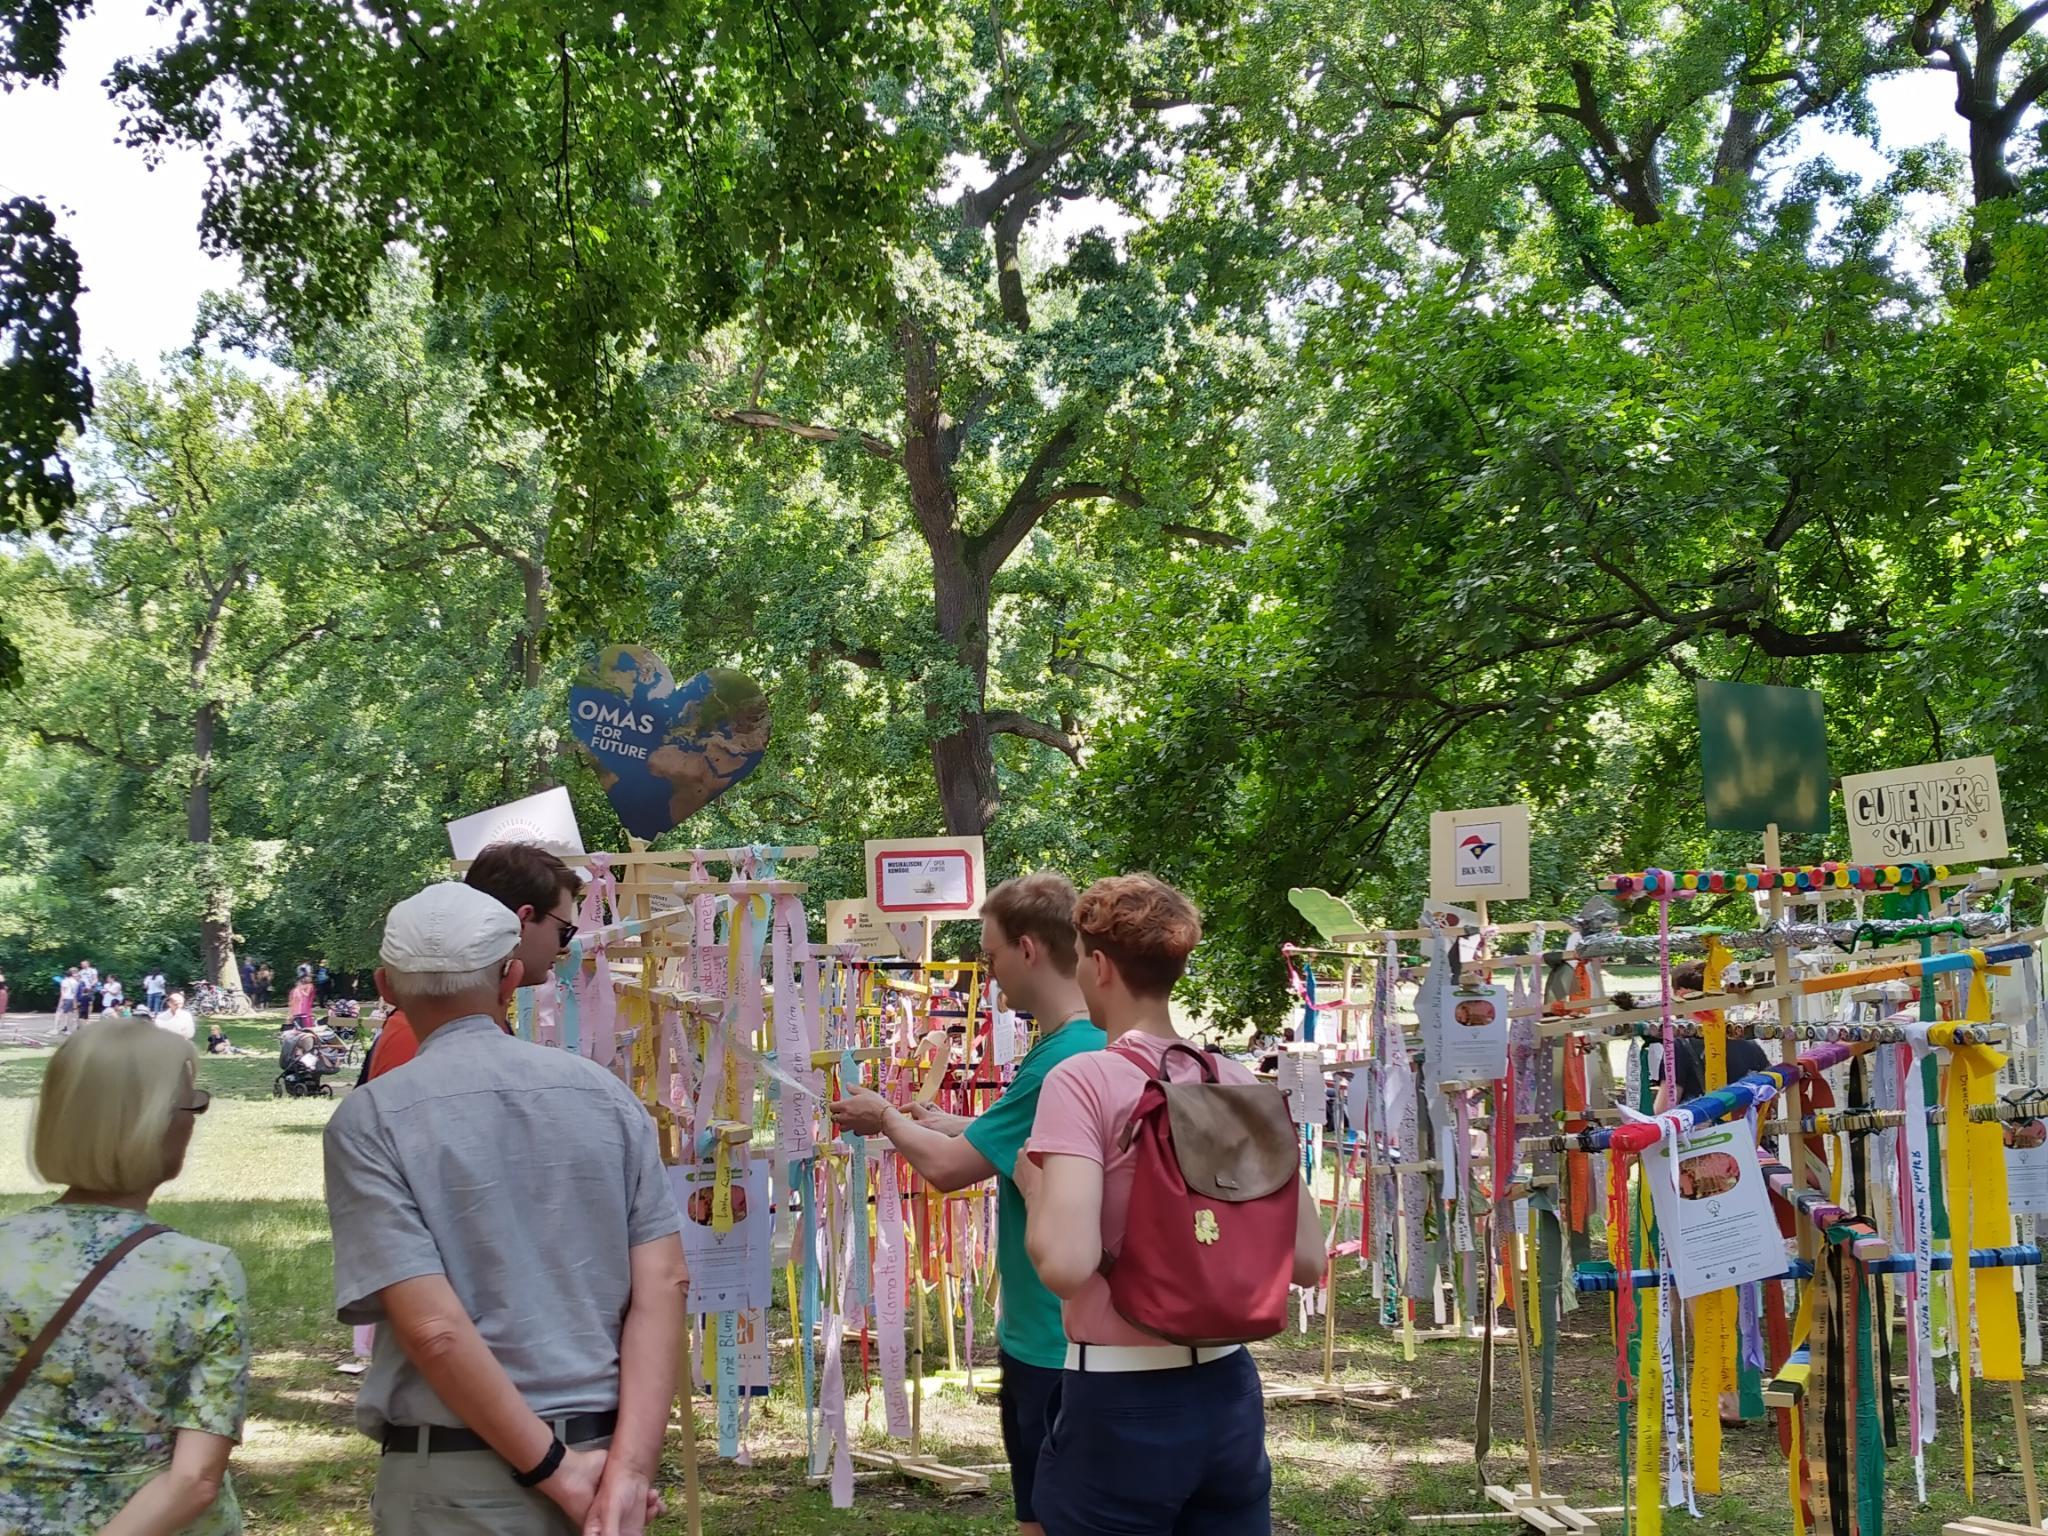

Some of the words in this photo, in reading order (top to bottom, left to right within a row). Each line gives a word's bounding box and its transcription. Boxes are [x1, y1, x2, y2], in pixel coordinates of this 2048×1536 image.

[578, 700, 655, 734] OMAS
[594, 723, 622, 740] FOR
[590, 736, 648, 760] FUTURE
[1853, 774, 1991, 826] GUTENBERG
[1883, 816, 1965, 857] SCHULE
[1462, 866, 1496, 876] BKK-VBU
[786, 1092, 807, 1154] Heizung
[883, 1244, 899, 1326] Klamotten
[721, 1356, 736, 1375] mit
[721, 1384, 737, 1440] Garten
